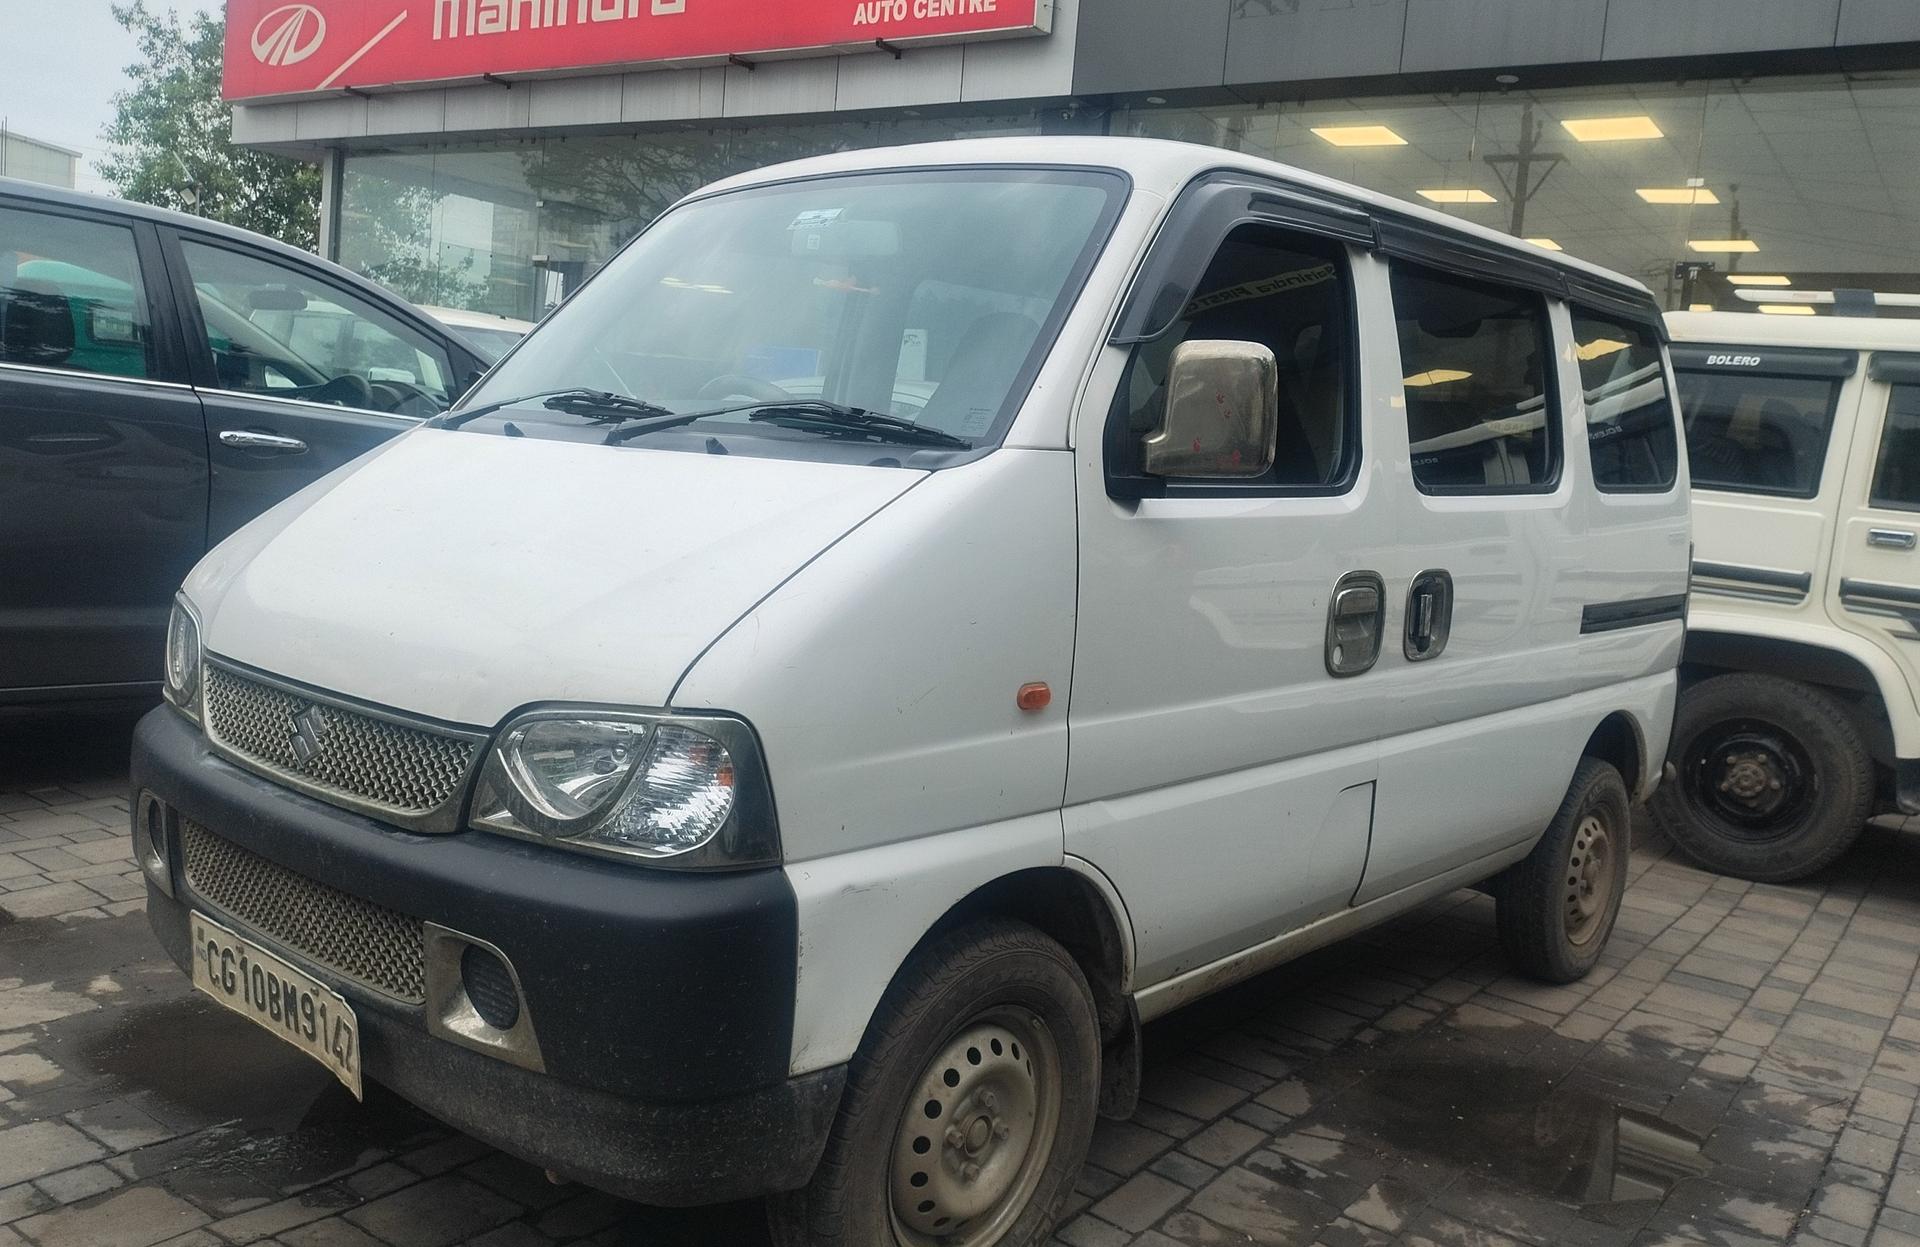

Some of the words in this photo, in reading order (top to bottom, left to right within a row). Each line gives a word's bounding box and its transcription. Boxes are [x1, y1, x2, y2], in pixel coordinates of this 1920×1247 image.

[852, 0, 908, 26] AUTO
[913, 0, 997, 19] CENTRE
[1706, 354, 1761, 367] BOLERO
[207, 938, 354, 1074] CG10BM9147
